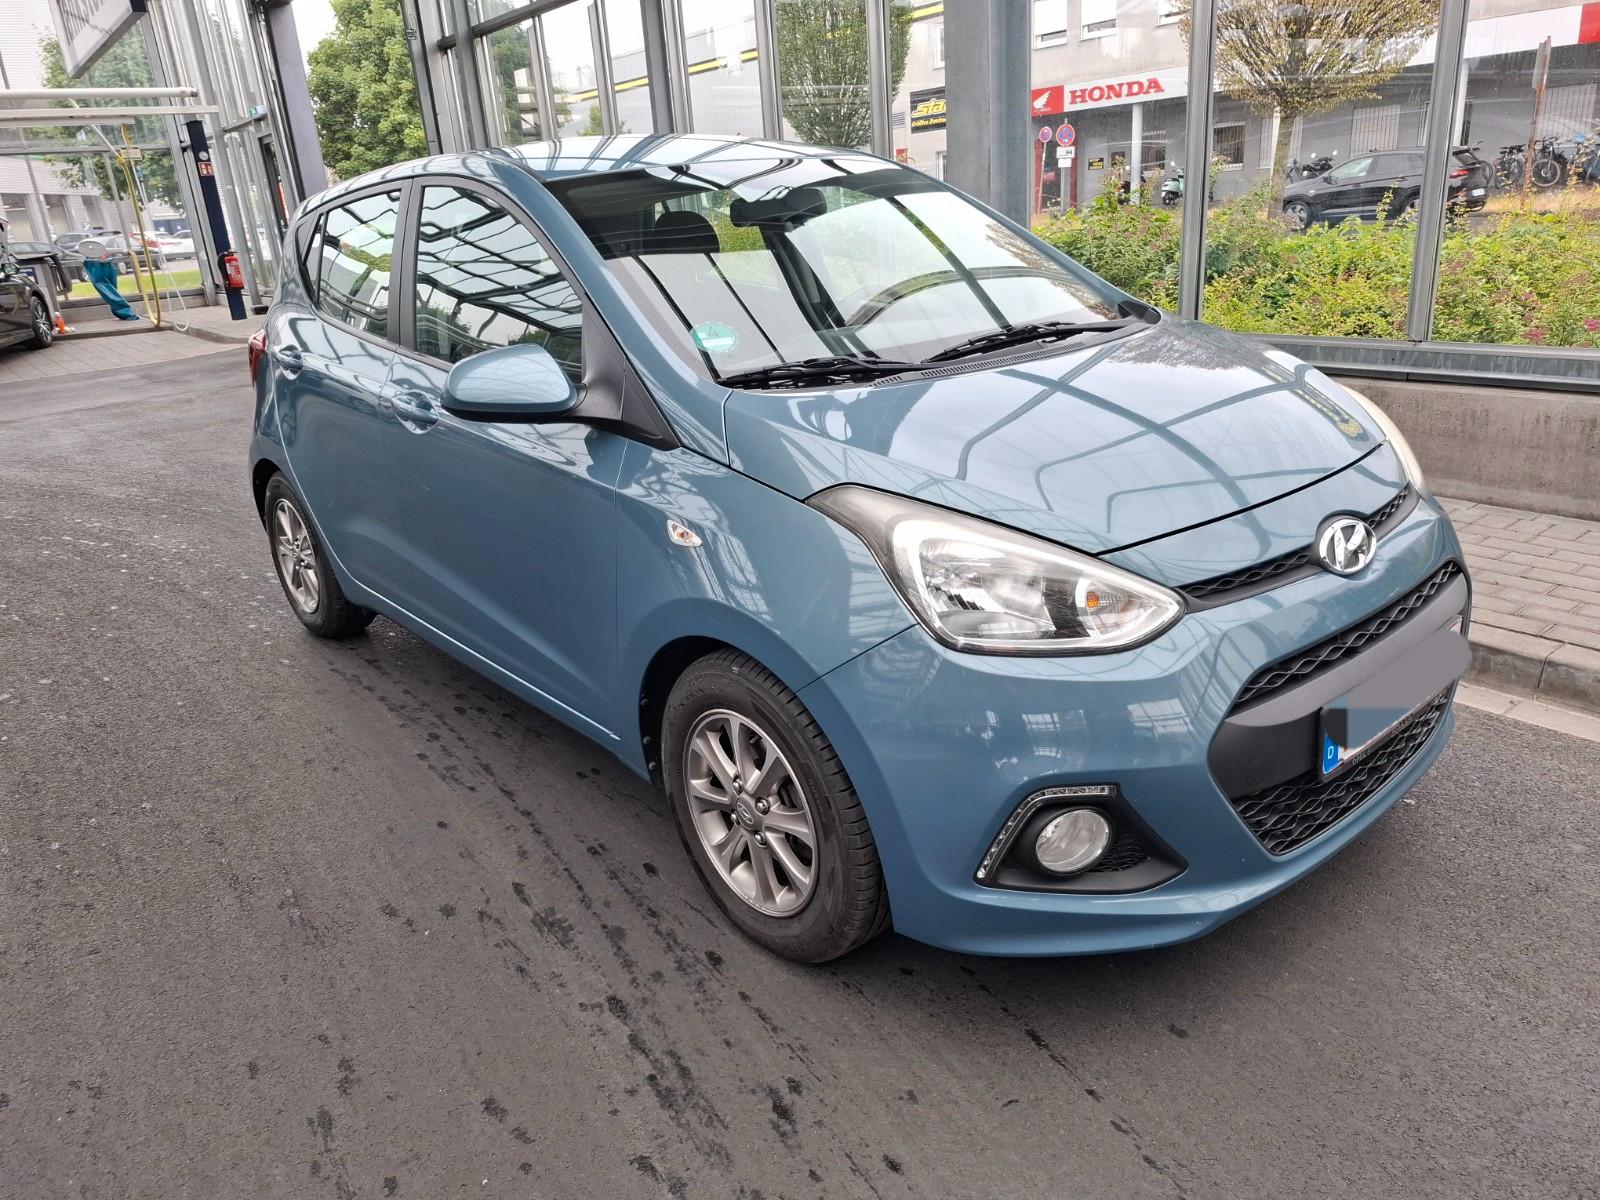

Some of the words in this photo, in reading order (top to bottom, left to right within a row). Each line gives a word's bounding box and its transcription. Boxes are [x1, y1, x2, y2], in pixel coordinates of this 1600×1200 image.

[1069, 78, 1165, 105] HONDA
[911, 98, 946, 118] sta
[1327, 745, 1334, 760] D
